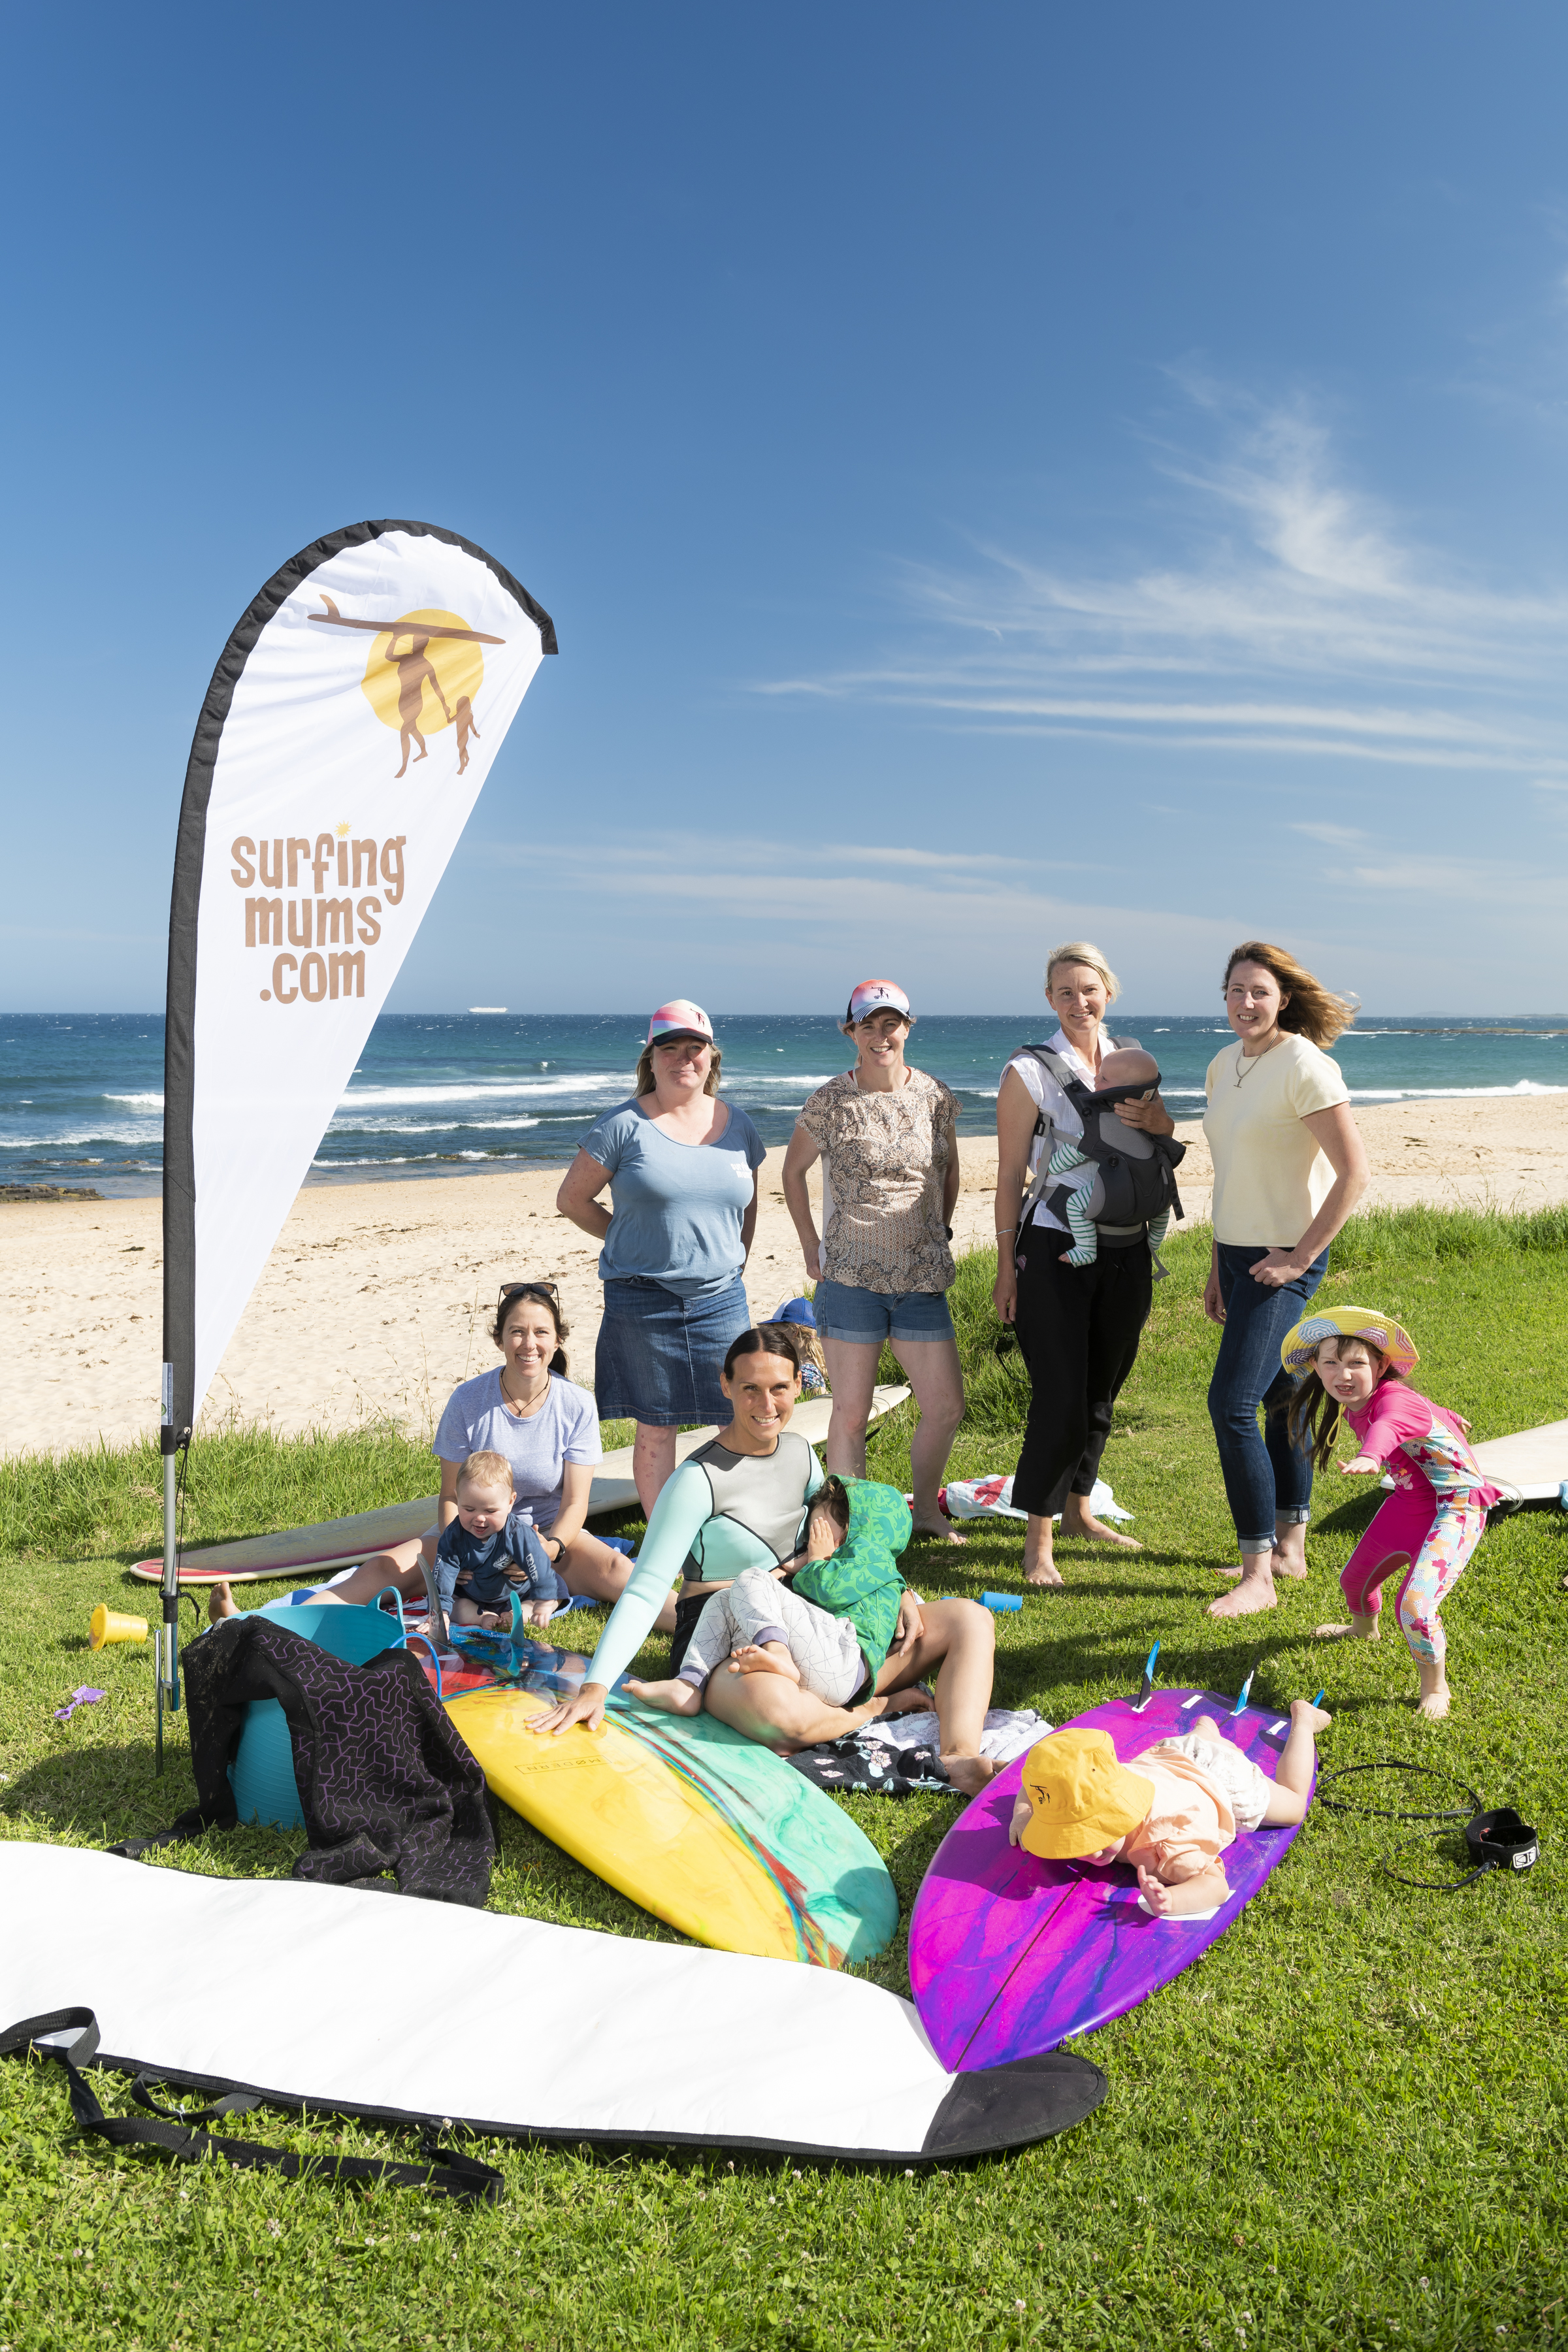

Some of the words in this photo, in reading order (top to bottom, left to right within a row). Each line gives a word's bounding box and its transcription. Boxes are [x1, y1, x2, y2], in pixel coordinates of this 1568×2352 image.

[231, 821, 406, 906] surfing
[244, 896, 382, 949] mums
[259, 949, 365, 1004] .com
